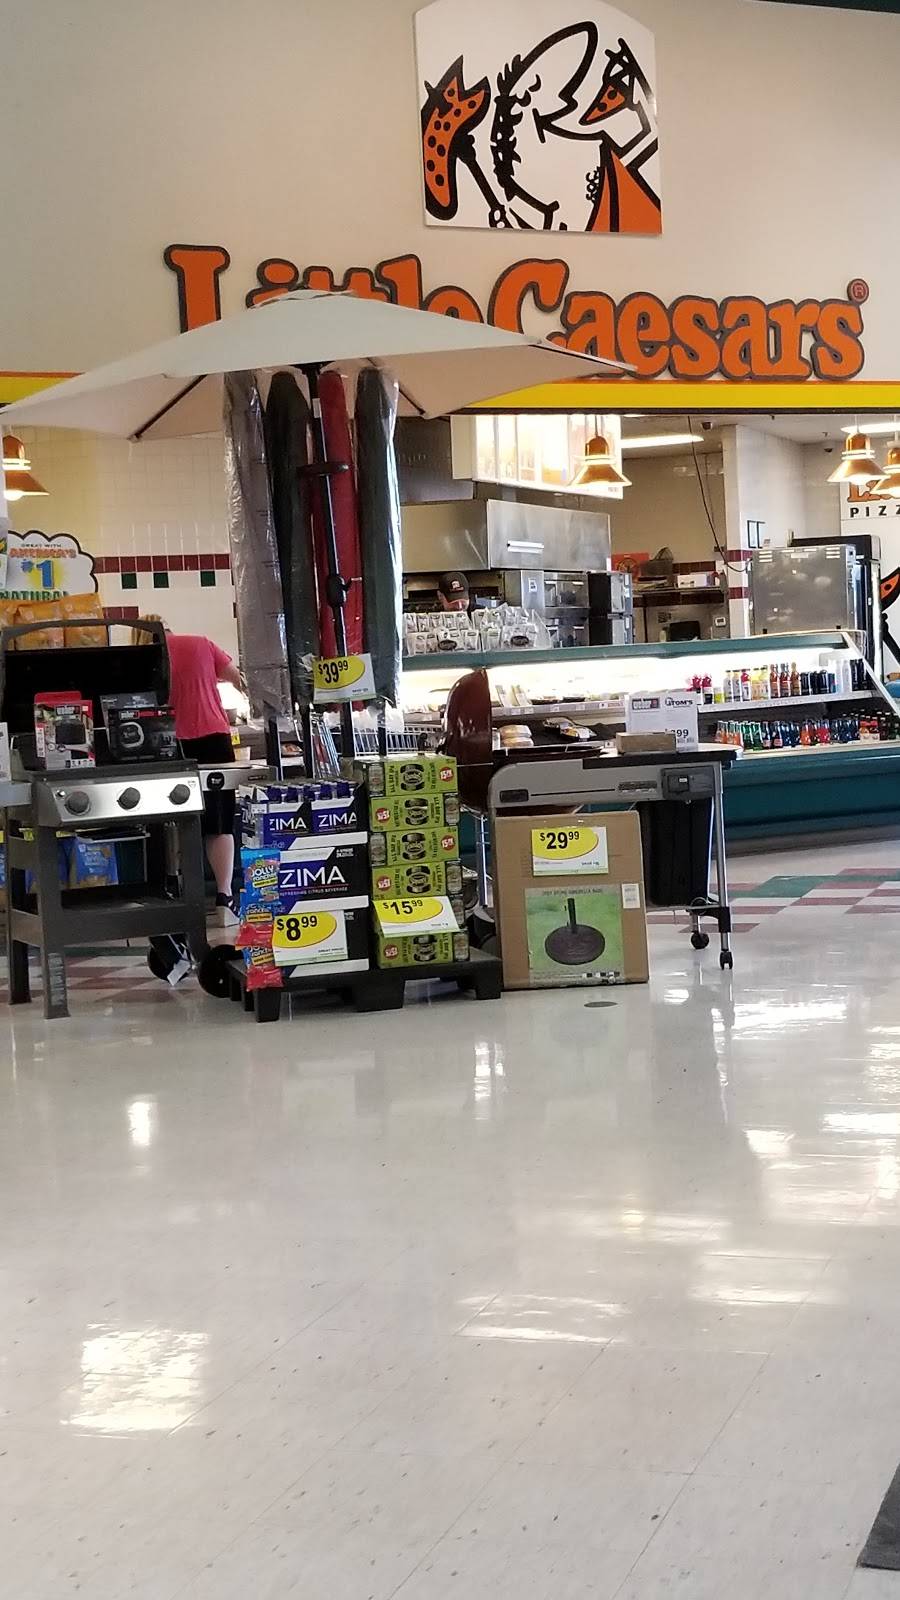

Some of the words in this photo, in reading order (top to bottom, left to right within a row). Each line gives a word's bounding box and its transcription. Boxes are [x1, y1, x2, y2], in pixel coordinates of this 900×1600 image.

[0, 590, 68, 600] NATURA
[318, 812, 357, 828] ZIMA
[251, 865, 274, 877] JOLLY
[279, 865, 346, 889] ZIMA
